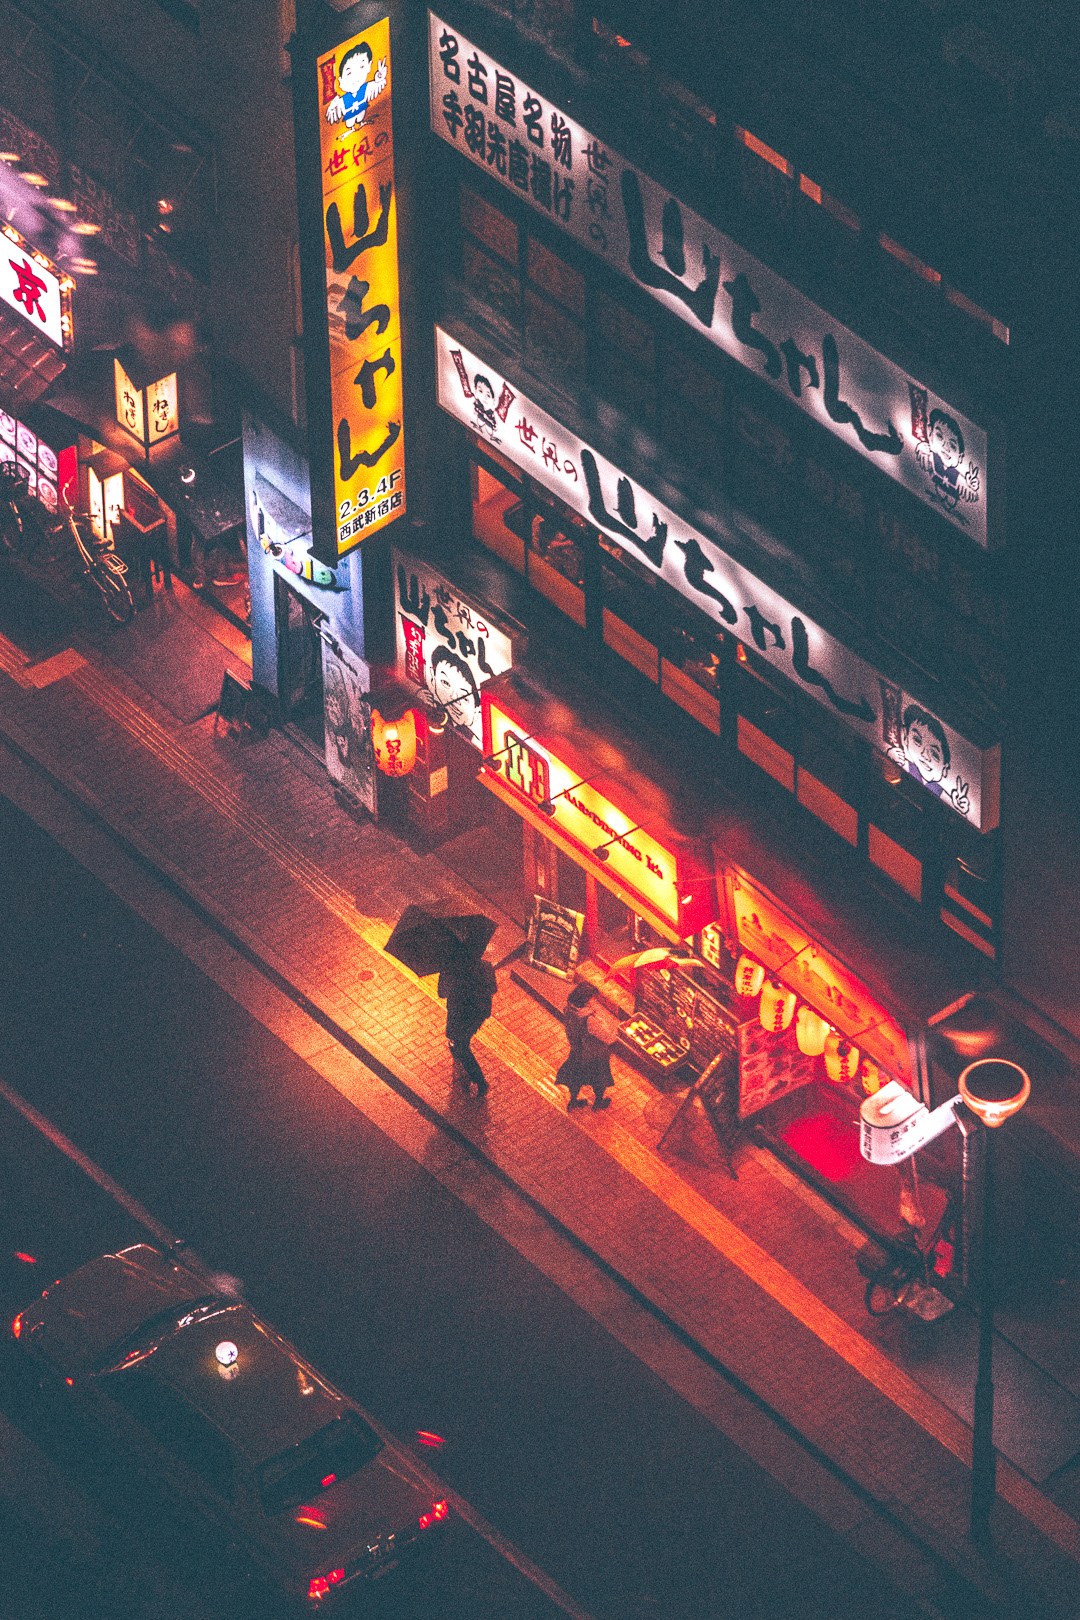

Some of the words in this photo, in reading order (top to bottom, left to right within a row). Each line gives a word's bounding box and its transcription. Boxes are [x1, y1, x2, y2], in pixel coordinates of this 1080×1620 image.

[324, 131, 390, 177] 世界の
[439, 28, 573, 170] 名古屋名物
[442, 89, 575, 223] 手羽先唐揚げ
[326, 179, 401, 481] 山ちゃん
[620, 168, 904, 456] 山ちゃん
[339, 491, 402, 541] 西武新宿店
[514, 416, 578, 482] 世界の
[580, 448, 877, 723] 山ちゃん
